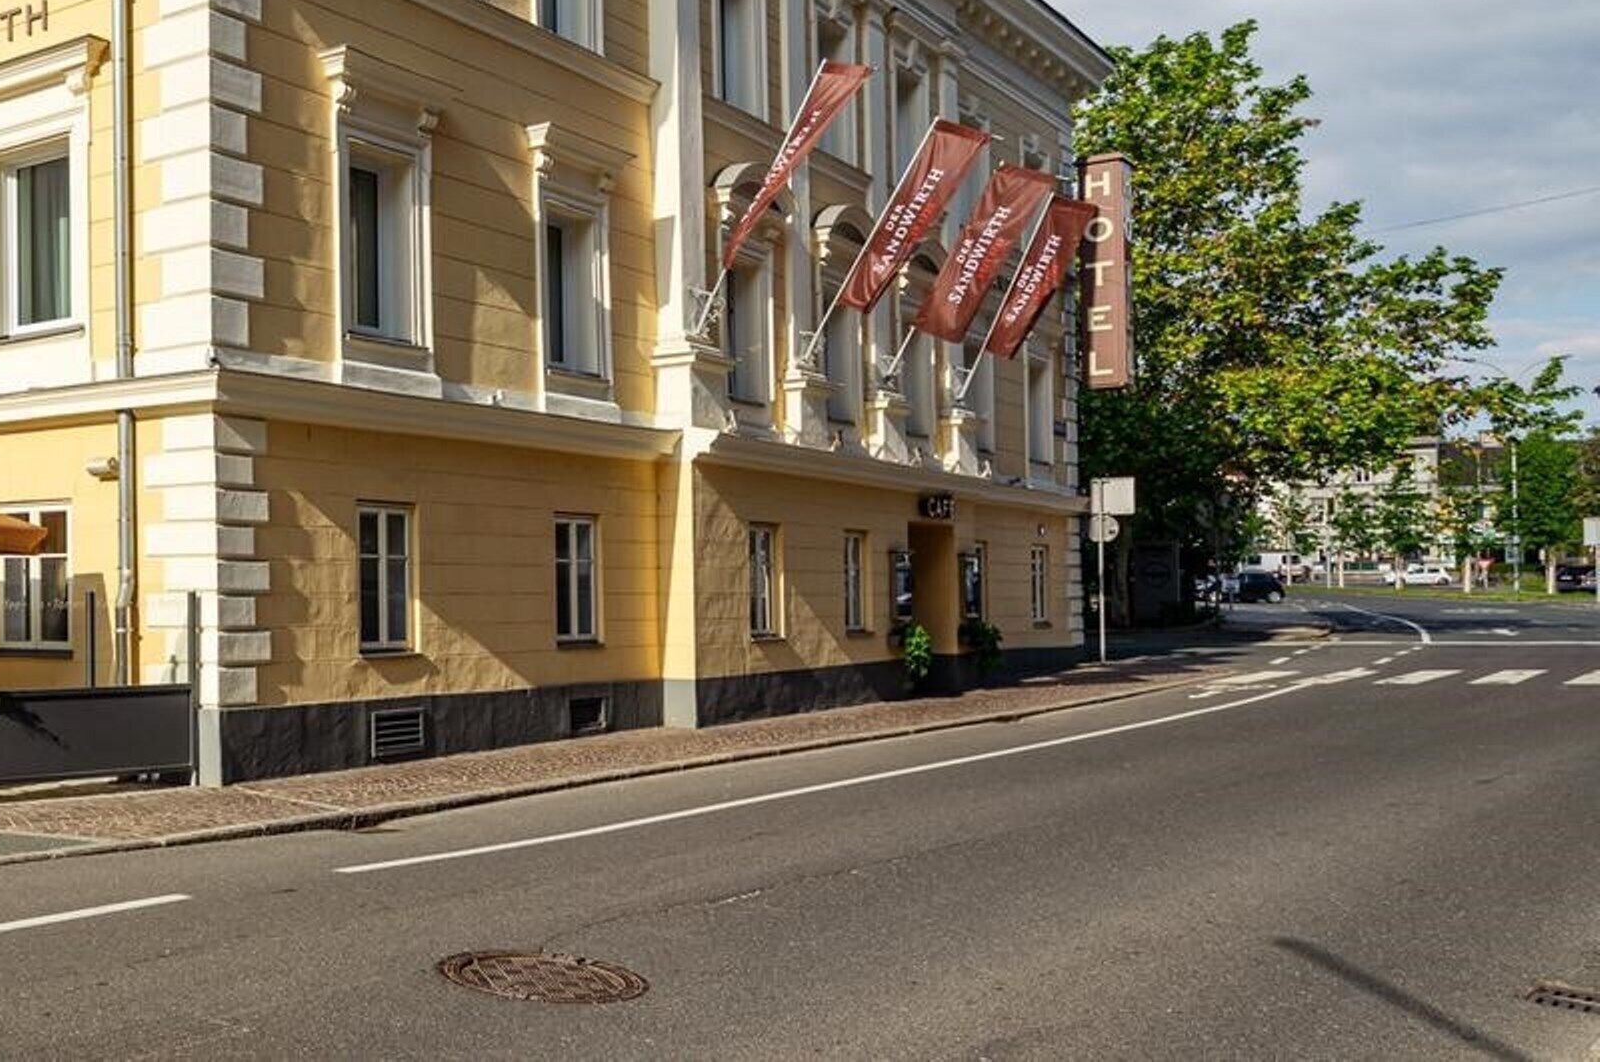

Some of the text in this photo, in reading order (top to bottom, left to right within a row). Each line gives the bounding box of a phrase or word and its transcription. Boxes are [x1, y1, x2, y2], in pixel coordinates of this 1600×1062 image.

[872, 168, 944, 274] SANDWIRTH
[884, 203, 906, 232] DER
[947, 206, 1012, 305] SANDWIRTH
[1004, 234, 1062, 323] SANDWIRTH
[1084, 170, 1115, 377] HOTEL
